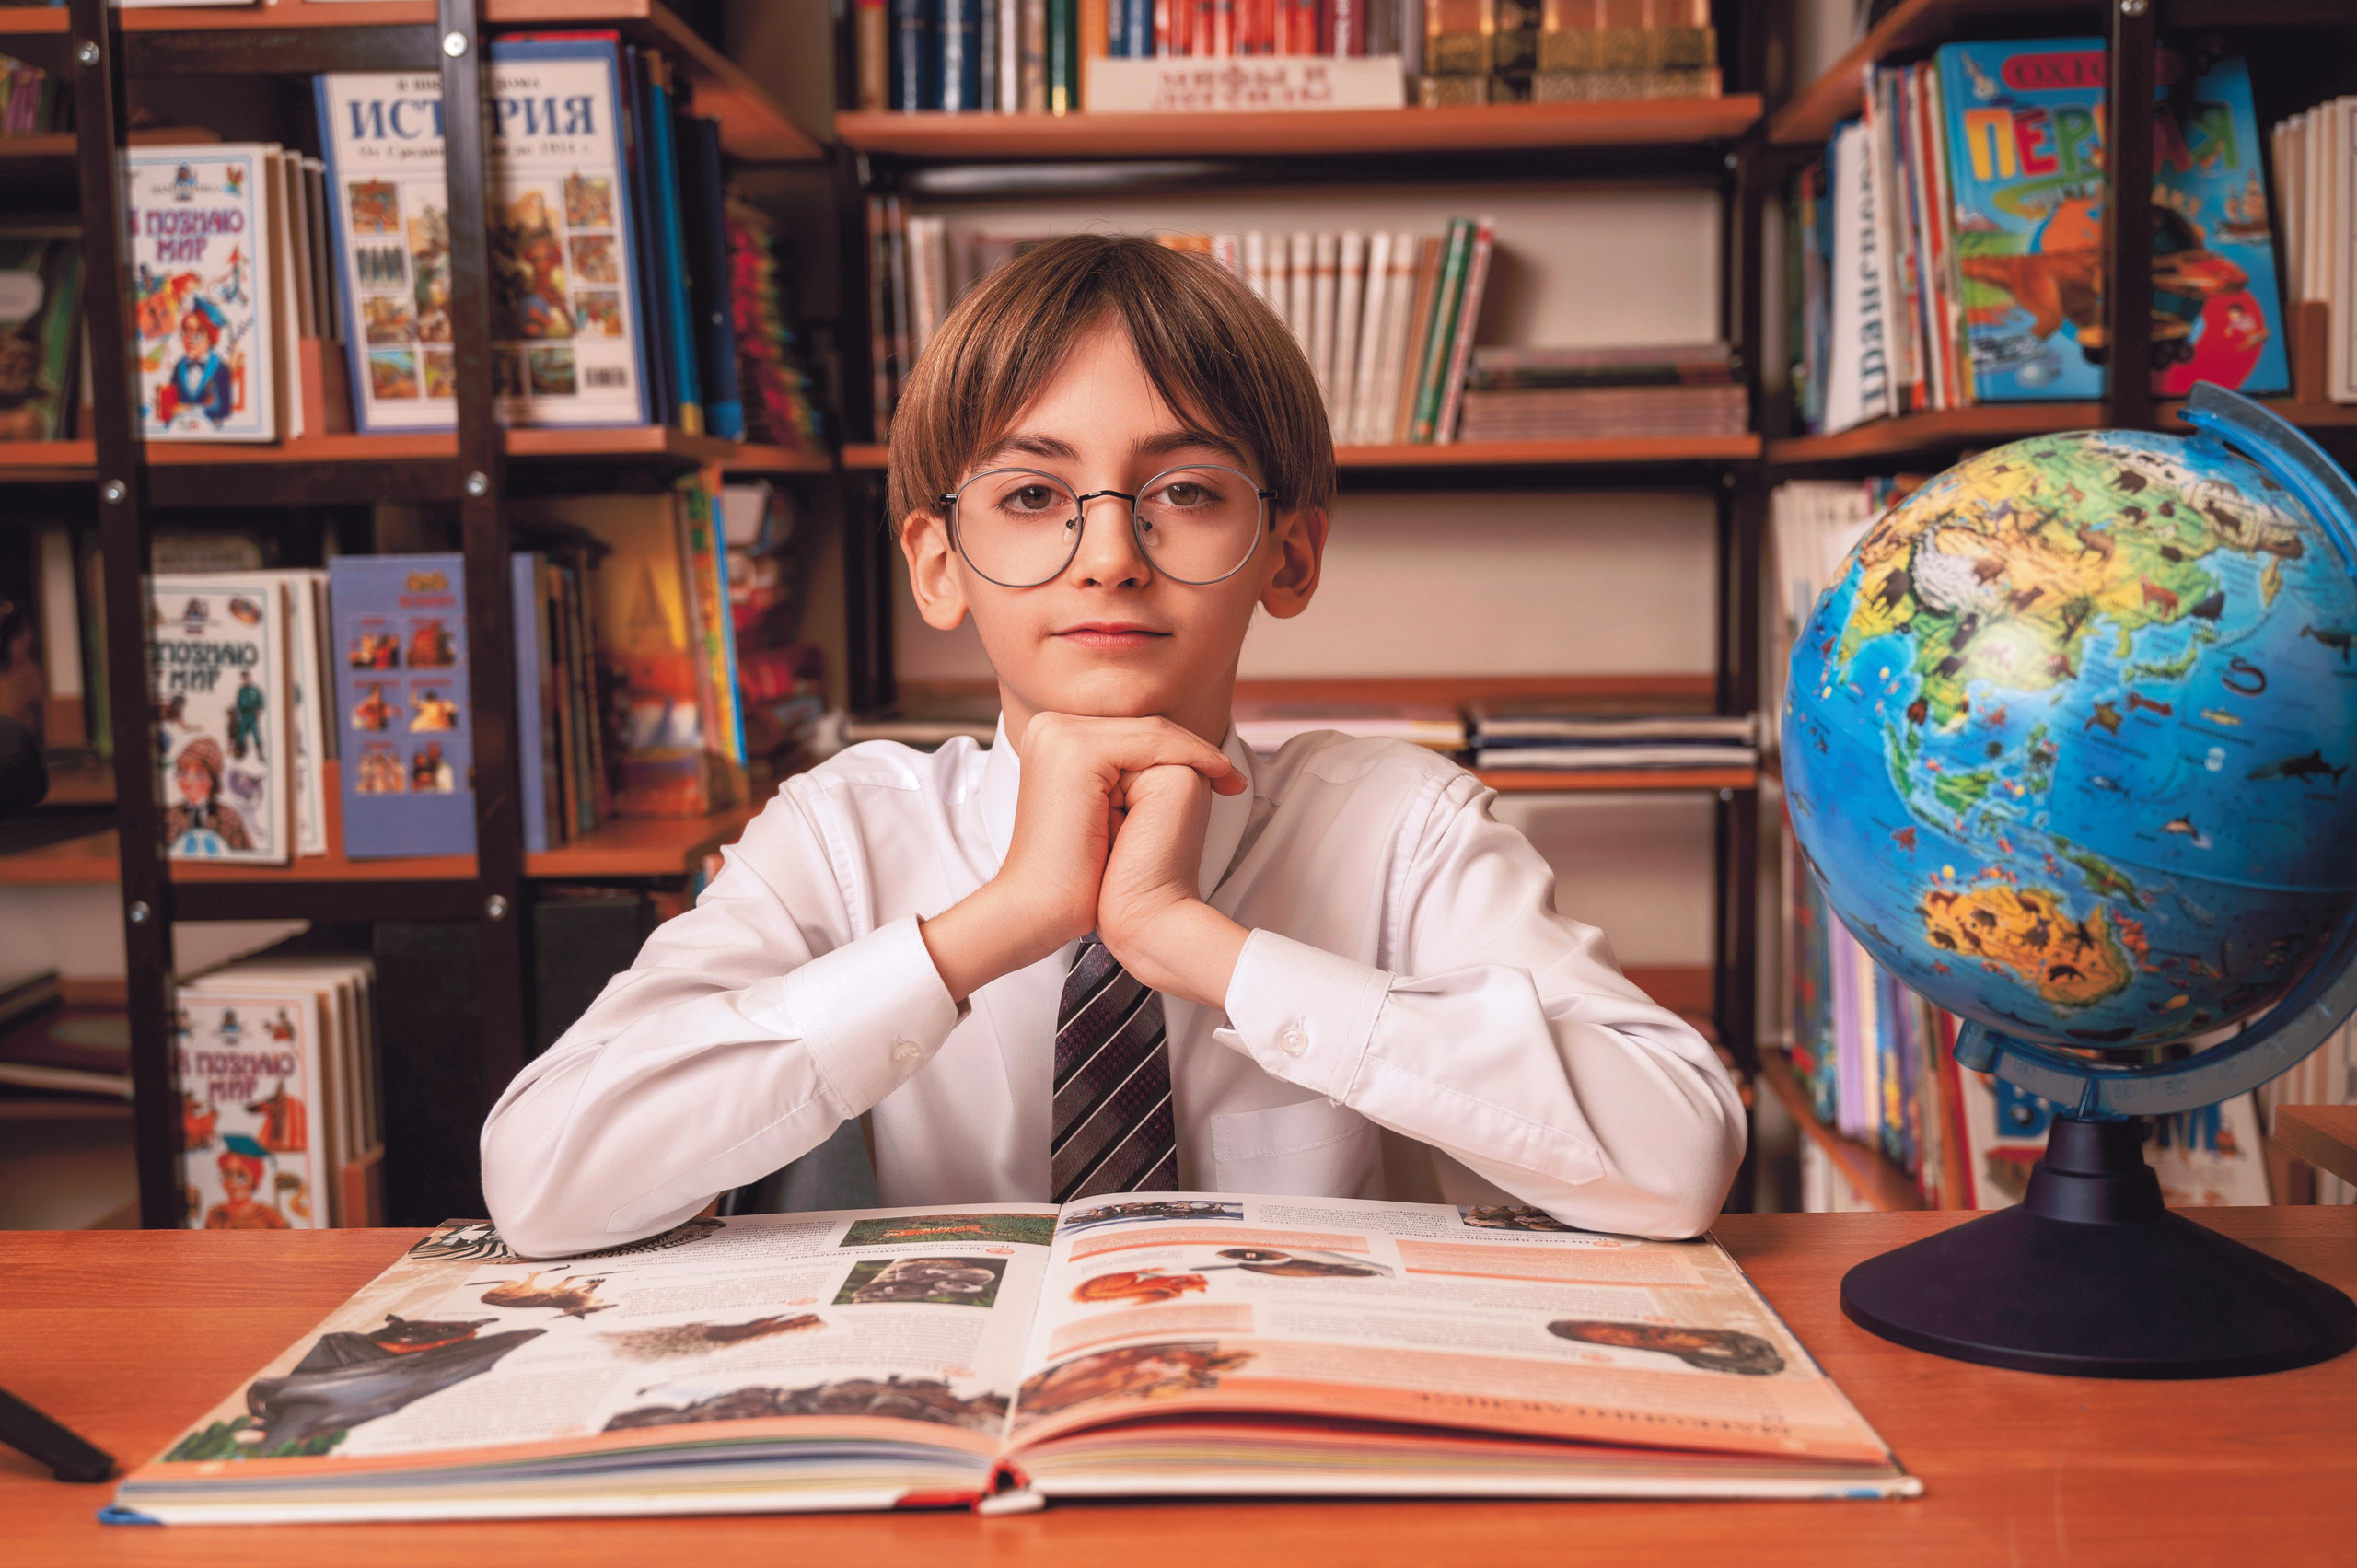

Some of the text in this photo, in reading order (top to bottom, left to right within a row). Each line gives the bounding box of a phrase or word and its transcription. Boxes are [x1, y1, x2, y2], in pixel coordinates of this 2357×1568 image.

[346, 95, 597, 141] ИСТРИЯ
[1964, 101, 2239, 182] ПЕРАЯ
[145, 207, 246, 236] ПОЗНАЮ
[156, 236, 208, 263] МИР
[169, 668, 220, 691] МИР
[196, 1050, 296, 1077] ПОЗНАЮ
[208, 1077, 258, 1101] МИР
